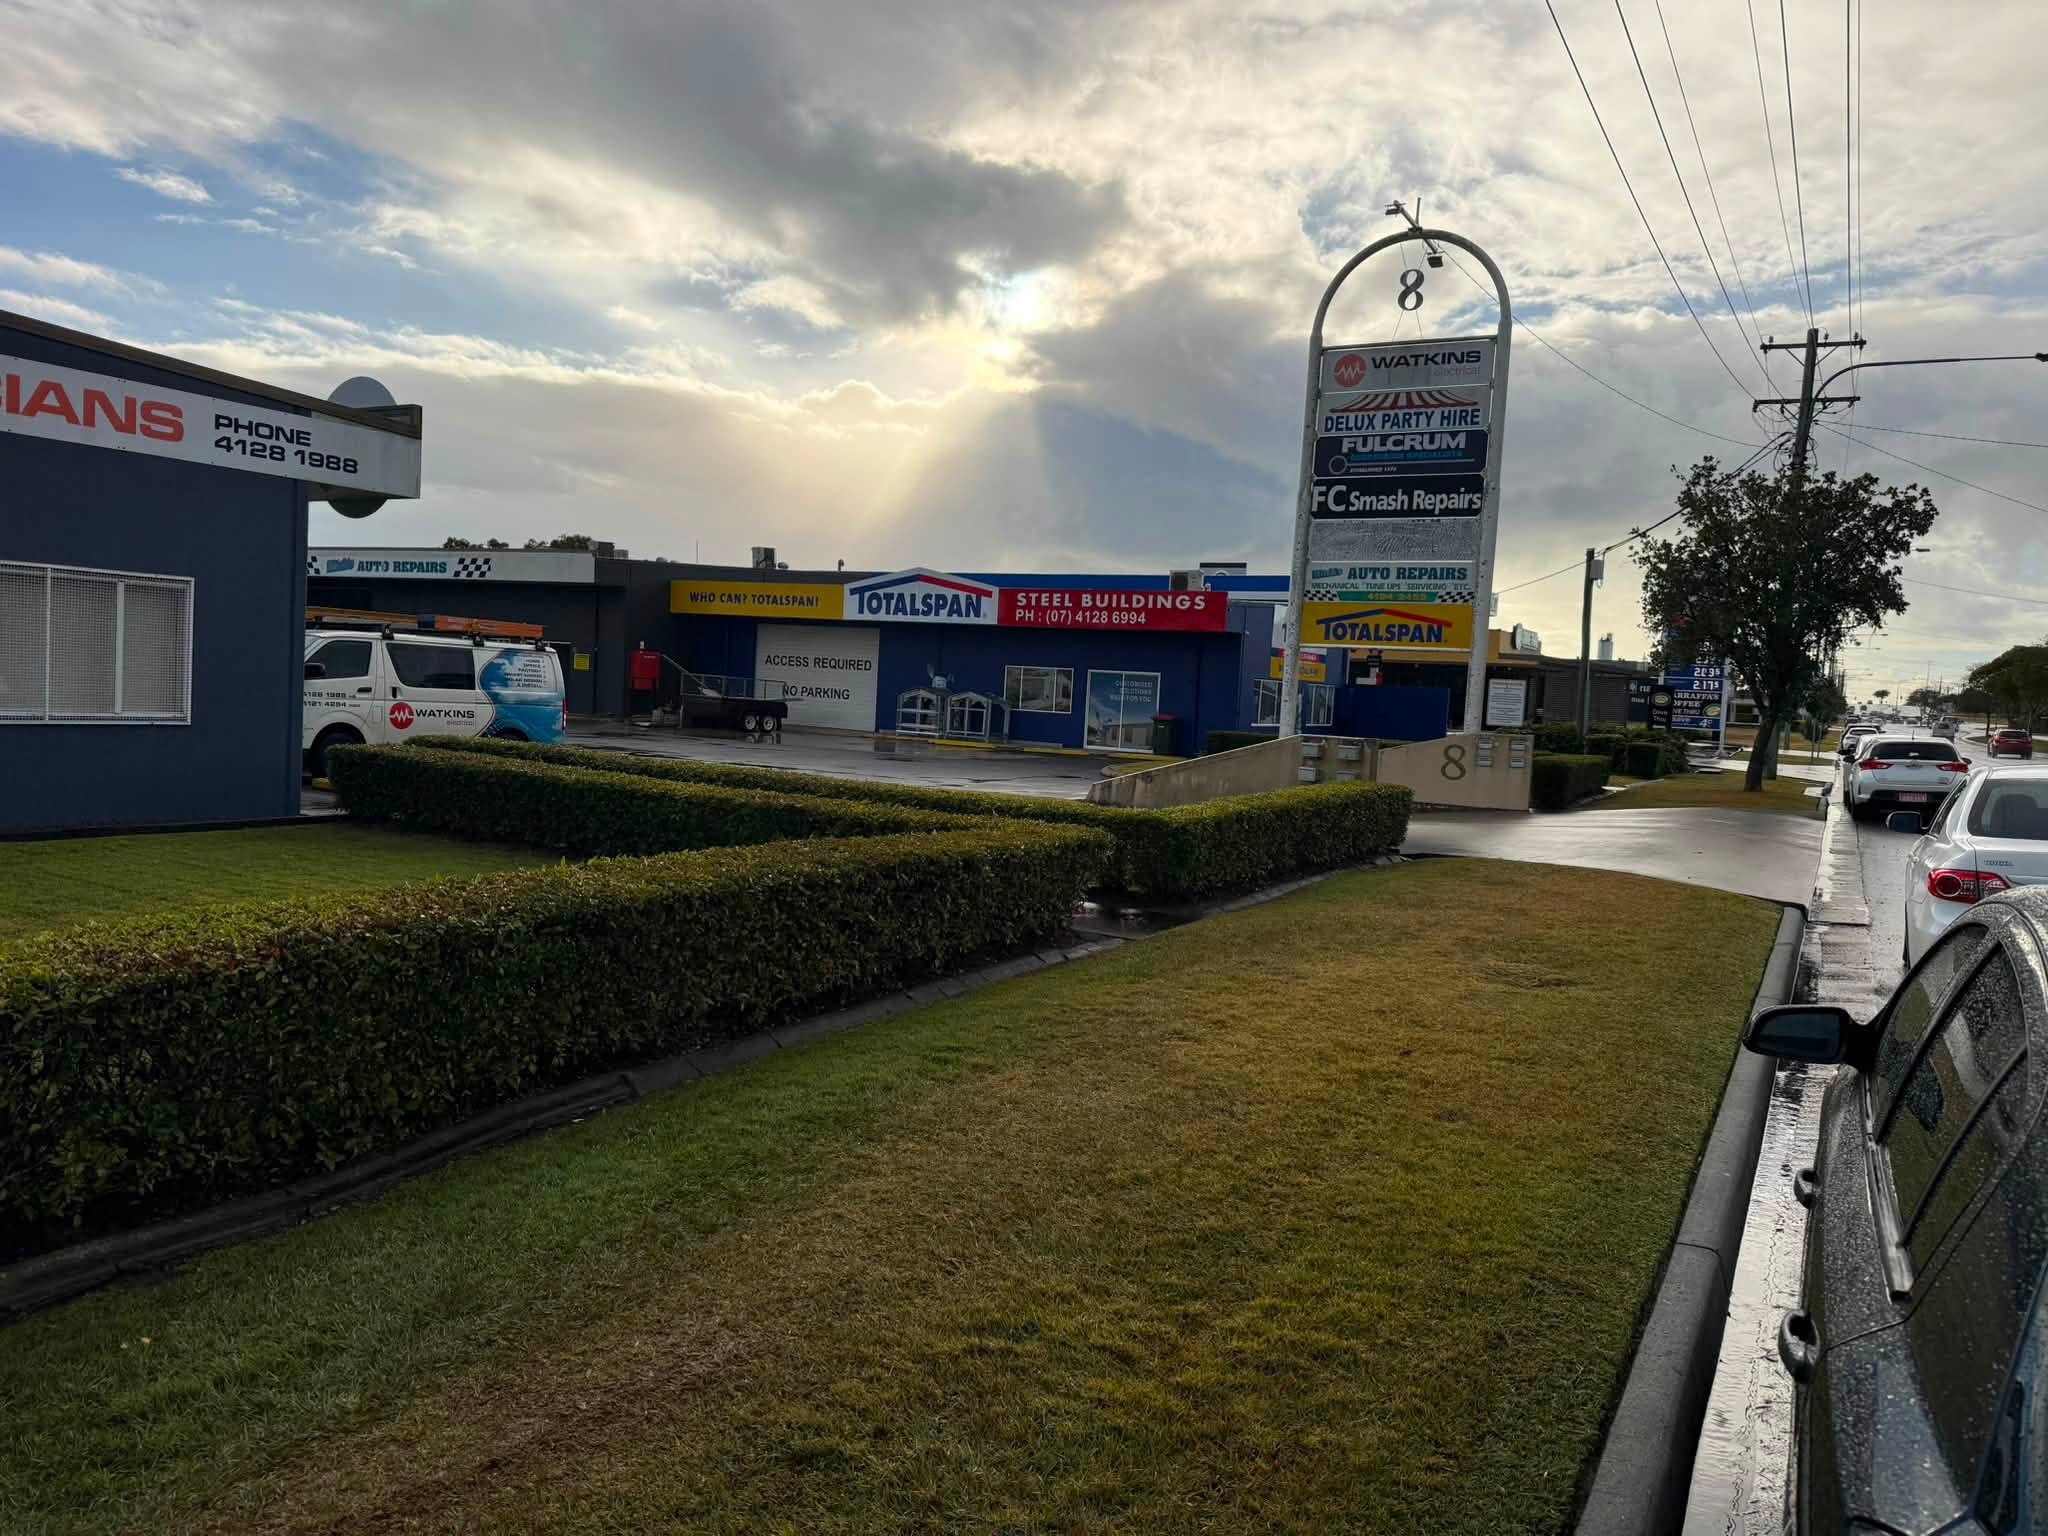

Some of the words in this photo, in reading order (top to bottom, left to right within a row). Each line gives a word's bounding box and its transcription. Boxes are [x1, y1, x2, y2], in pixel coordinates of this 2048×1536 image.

[1398, 269, 1424, 311] 8
[1371, 350, 1481, 369] WATKINS
[0, 373, 185, 443] IANS
[214, 413, 312, 447] PHONE
[1324, 413, 1377, 433] DELUX
[1381, 411, 1435, 431] PARTY
[1440, 408, 1481, 427] HIRE
[1341, 431, 1467, 454] FULCRUM
[214, 436, 286, 463] 4128
[294, 451, 359, 475] 1988
[1311, 484, 1348, 513] FC
[1349, 488, 1409, 512] Smash
[1412, 487, 1482, 515] Repairs
[357, 560, 389, 573] AUTO
[393, 561, 448, 574] REPAIRS
[1347, 567, 1391, 580] AUTO
[1396, 567, 1468, 580] REPAIRS
[689, 591, 716, 603] WHO
[720, 592, 748, 605] CAN?
[751, 593, 820, 608] TOTALSPAN!
[854, 591, 982, 618] TOTALSPAN
[1017, 592, 1073, 608] STEEL
[1081, 594, 1206, 610] BUILDINGS
[1046, 609, 1072, 625] (07)
[1075, 610, 1109, 624] 4128
[1112, 611, 1147, 625] 6994
[1320, 621, 1444, 643] TOTALSPAN
[765, 654, 809, 668] ACCESS
[813, 656, 872, 672] REQUIRED
[782, 684, 798, 697] NO
[800, 685, 850, 701] PARKING
[415, 708, 475, 719] WATKINS
[1440, 744, 1466, 781] 8
